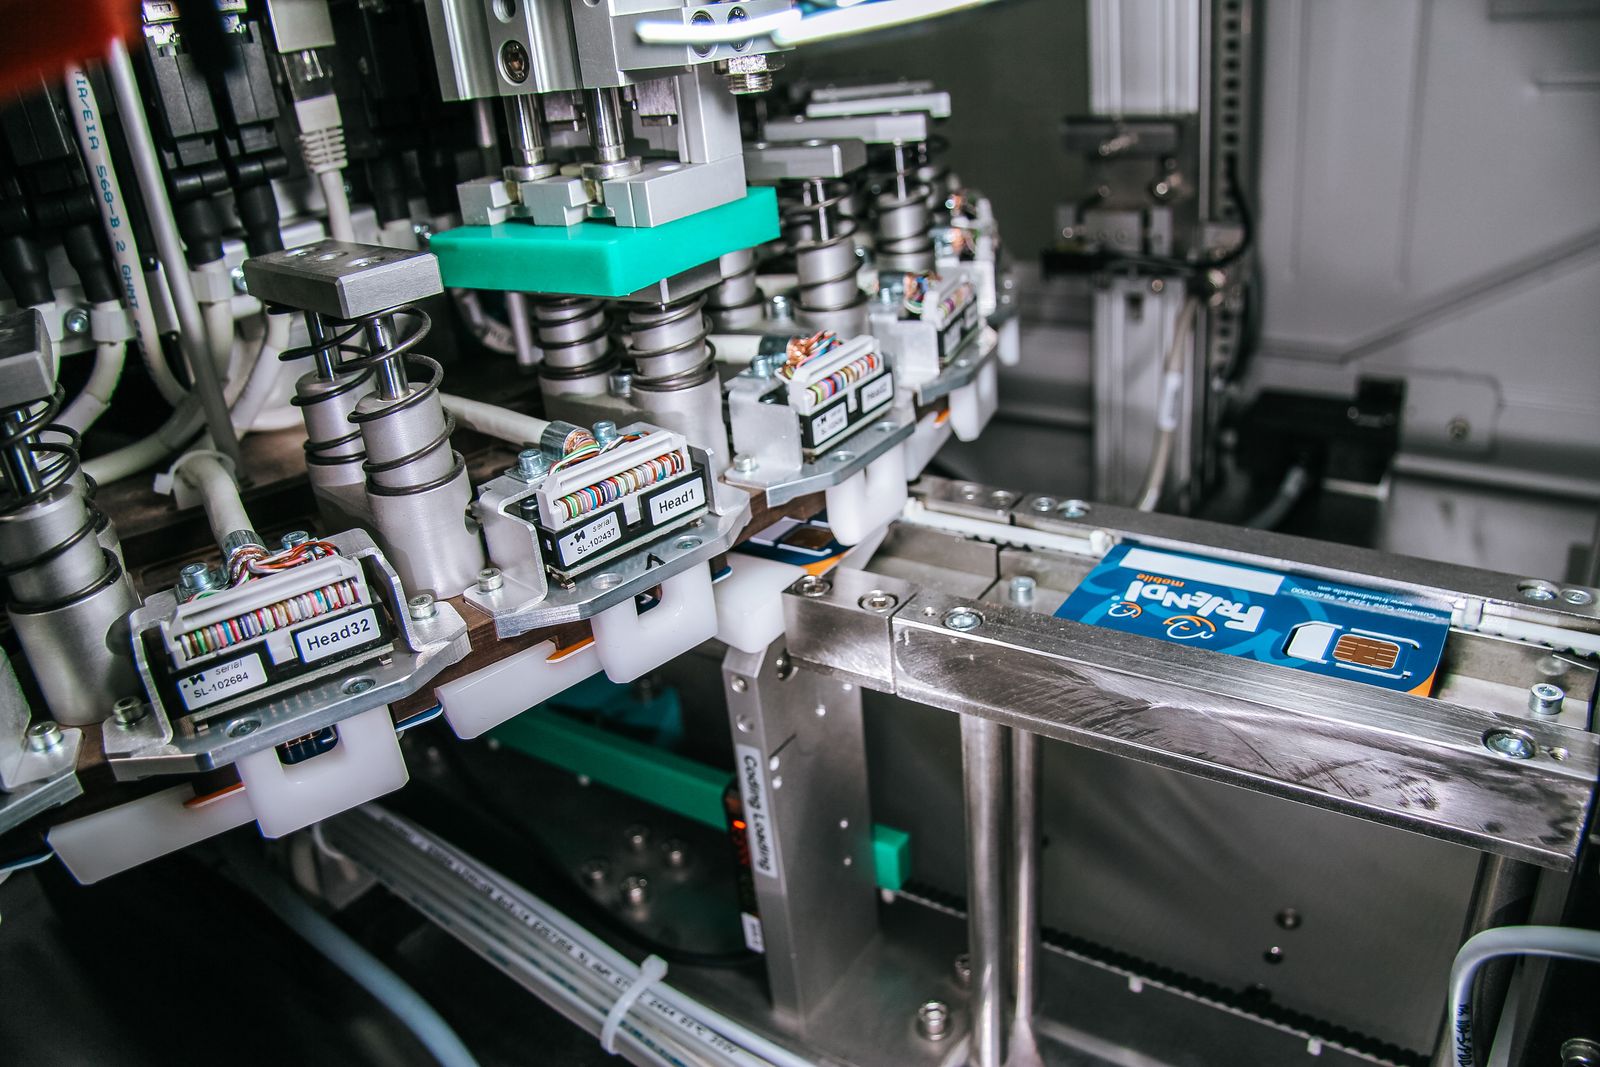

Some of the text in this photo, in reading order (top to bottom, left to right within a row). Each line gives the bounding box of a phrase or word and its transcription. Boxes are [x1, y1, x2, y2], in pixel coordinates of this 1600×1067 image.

[658, 488, 695, 514] Head1
[592, 515, 613, 533] serial
[576, 527, 616, 555] SL-102437
[1136, 573, 1185, 588] mobile
[1373, 602, 1394, 612] Care
[1397, 605, 1437, 620] Customer
[306, 618, 371, 651] Head32
[215, 659, 243, 676] serial
[193, 671, 249, 699] SL-102684
[743, 755, 771, 872] Coding Loading
